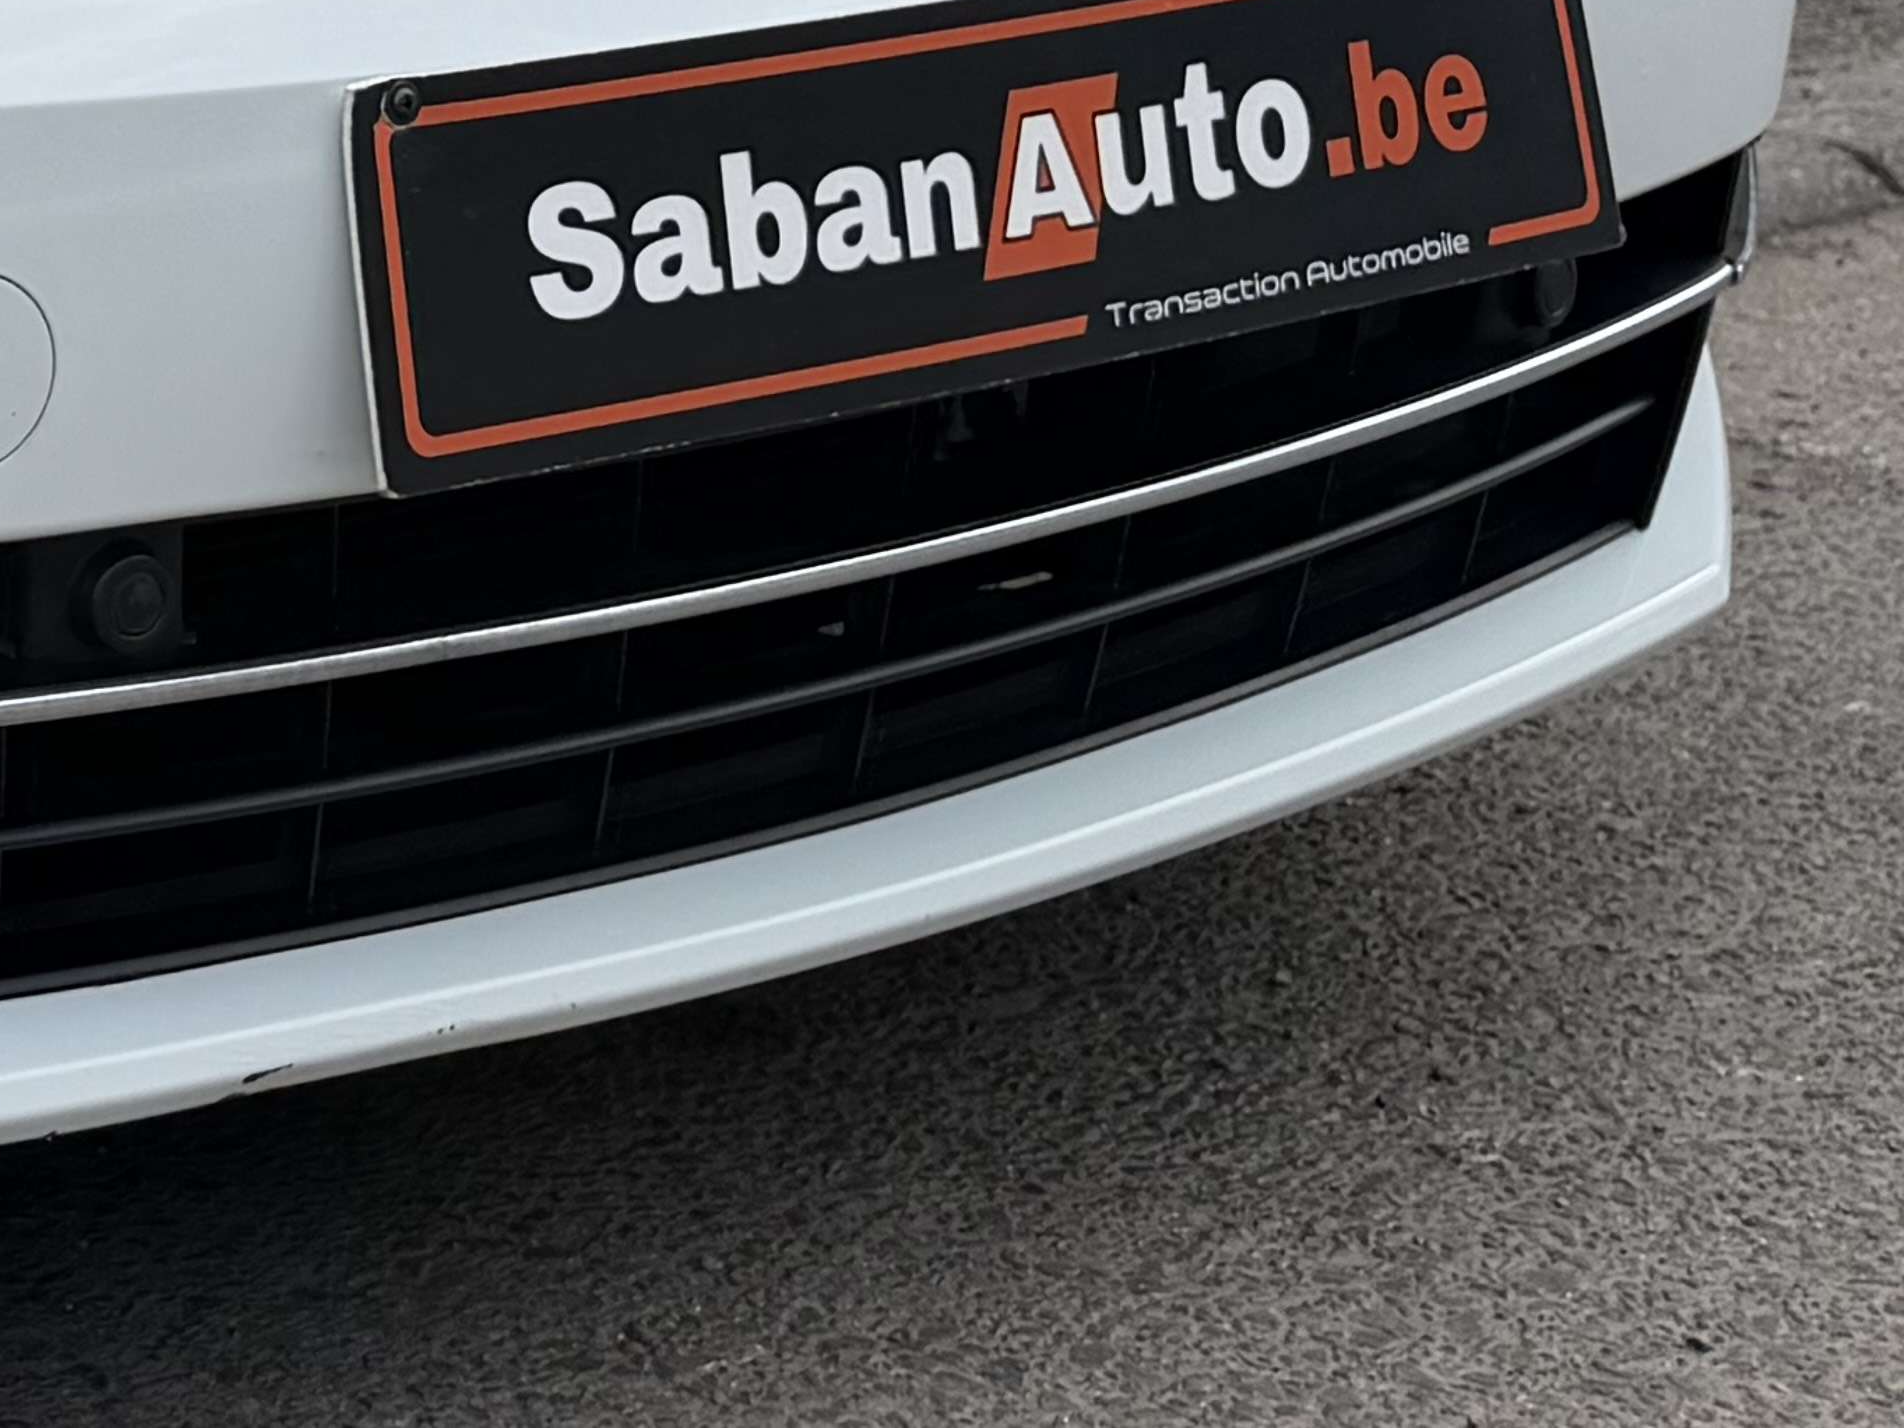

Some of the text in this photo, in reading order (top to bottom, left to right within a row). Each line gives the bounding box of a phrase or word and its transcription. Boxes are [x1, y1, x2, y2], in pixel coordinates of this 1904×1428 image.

[526, 38, 1490, 321] SabanAuto.be
[1103, 230, 1471, 328] Transaction Automobile
